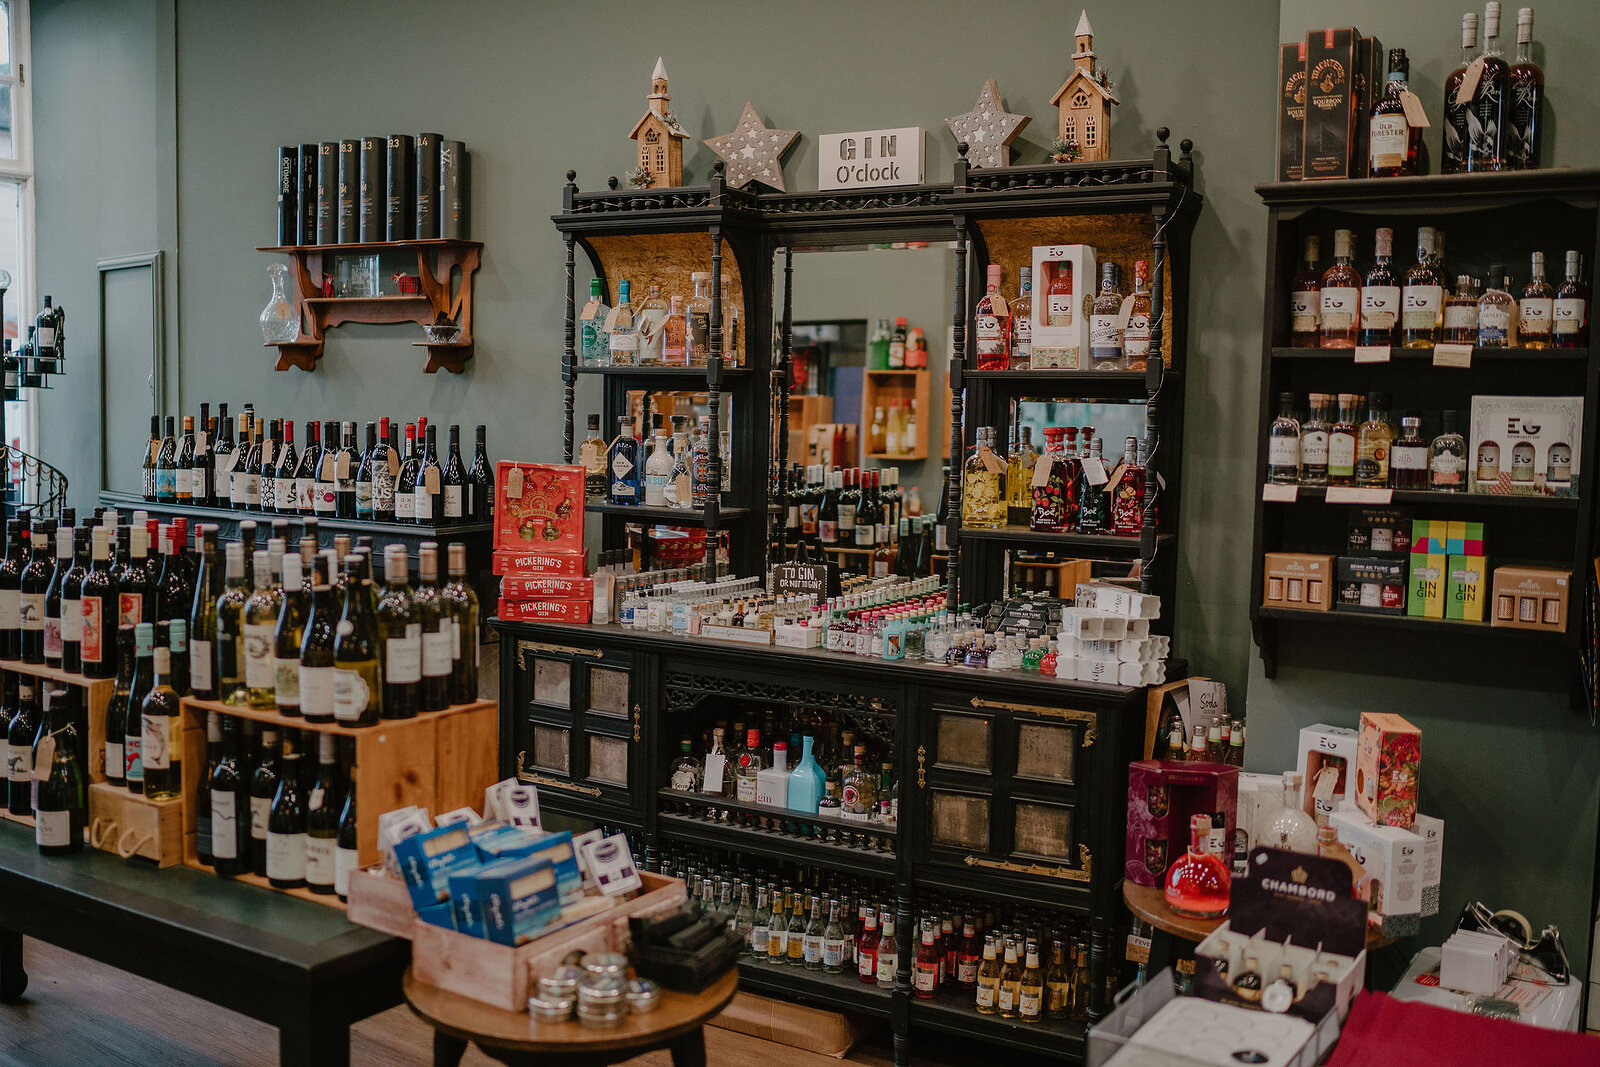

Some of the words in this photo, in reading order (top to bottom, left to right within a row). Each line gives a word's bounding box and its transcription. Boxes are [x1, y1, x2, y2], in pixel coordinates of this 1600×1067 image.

[1371, 129, 1404, 138] FORESTER
[840, 135, 897, 160] GIN
[836, 161, 900, 184] O'clock
[1507, 417, 1541, 435] EG
[515, 556, 562, 568] PICKERING'S
[782, 567, 795, 579] TO
[524, 580, 572, 591] PICKERING'S
[789, 580, 800, 588] NOT
[1419, 581, 1437, 590] LIN
[1458, 584, 1476, 593] LIN
[1416, 589, 1436, 598] GIN
[1455, 592, 1476, 601] GIN
[520, 602, 567, 613] PICKERING'S
[1200, 692, 1219, 709] Soda
[1320, 737, 1337, 749] EG
[1261, 877, 1337, 903] CHAMBORD
